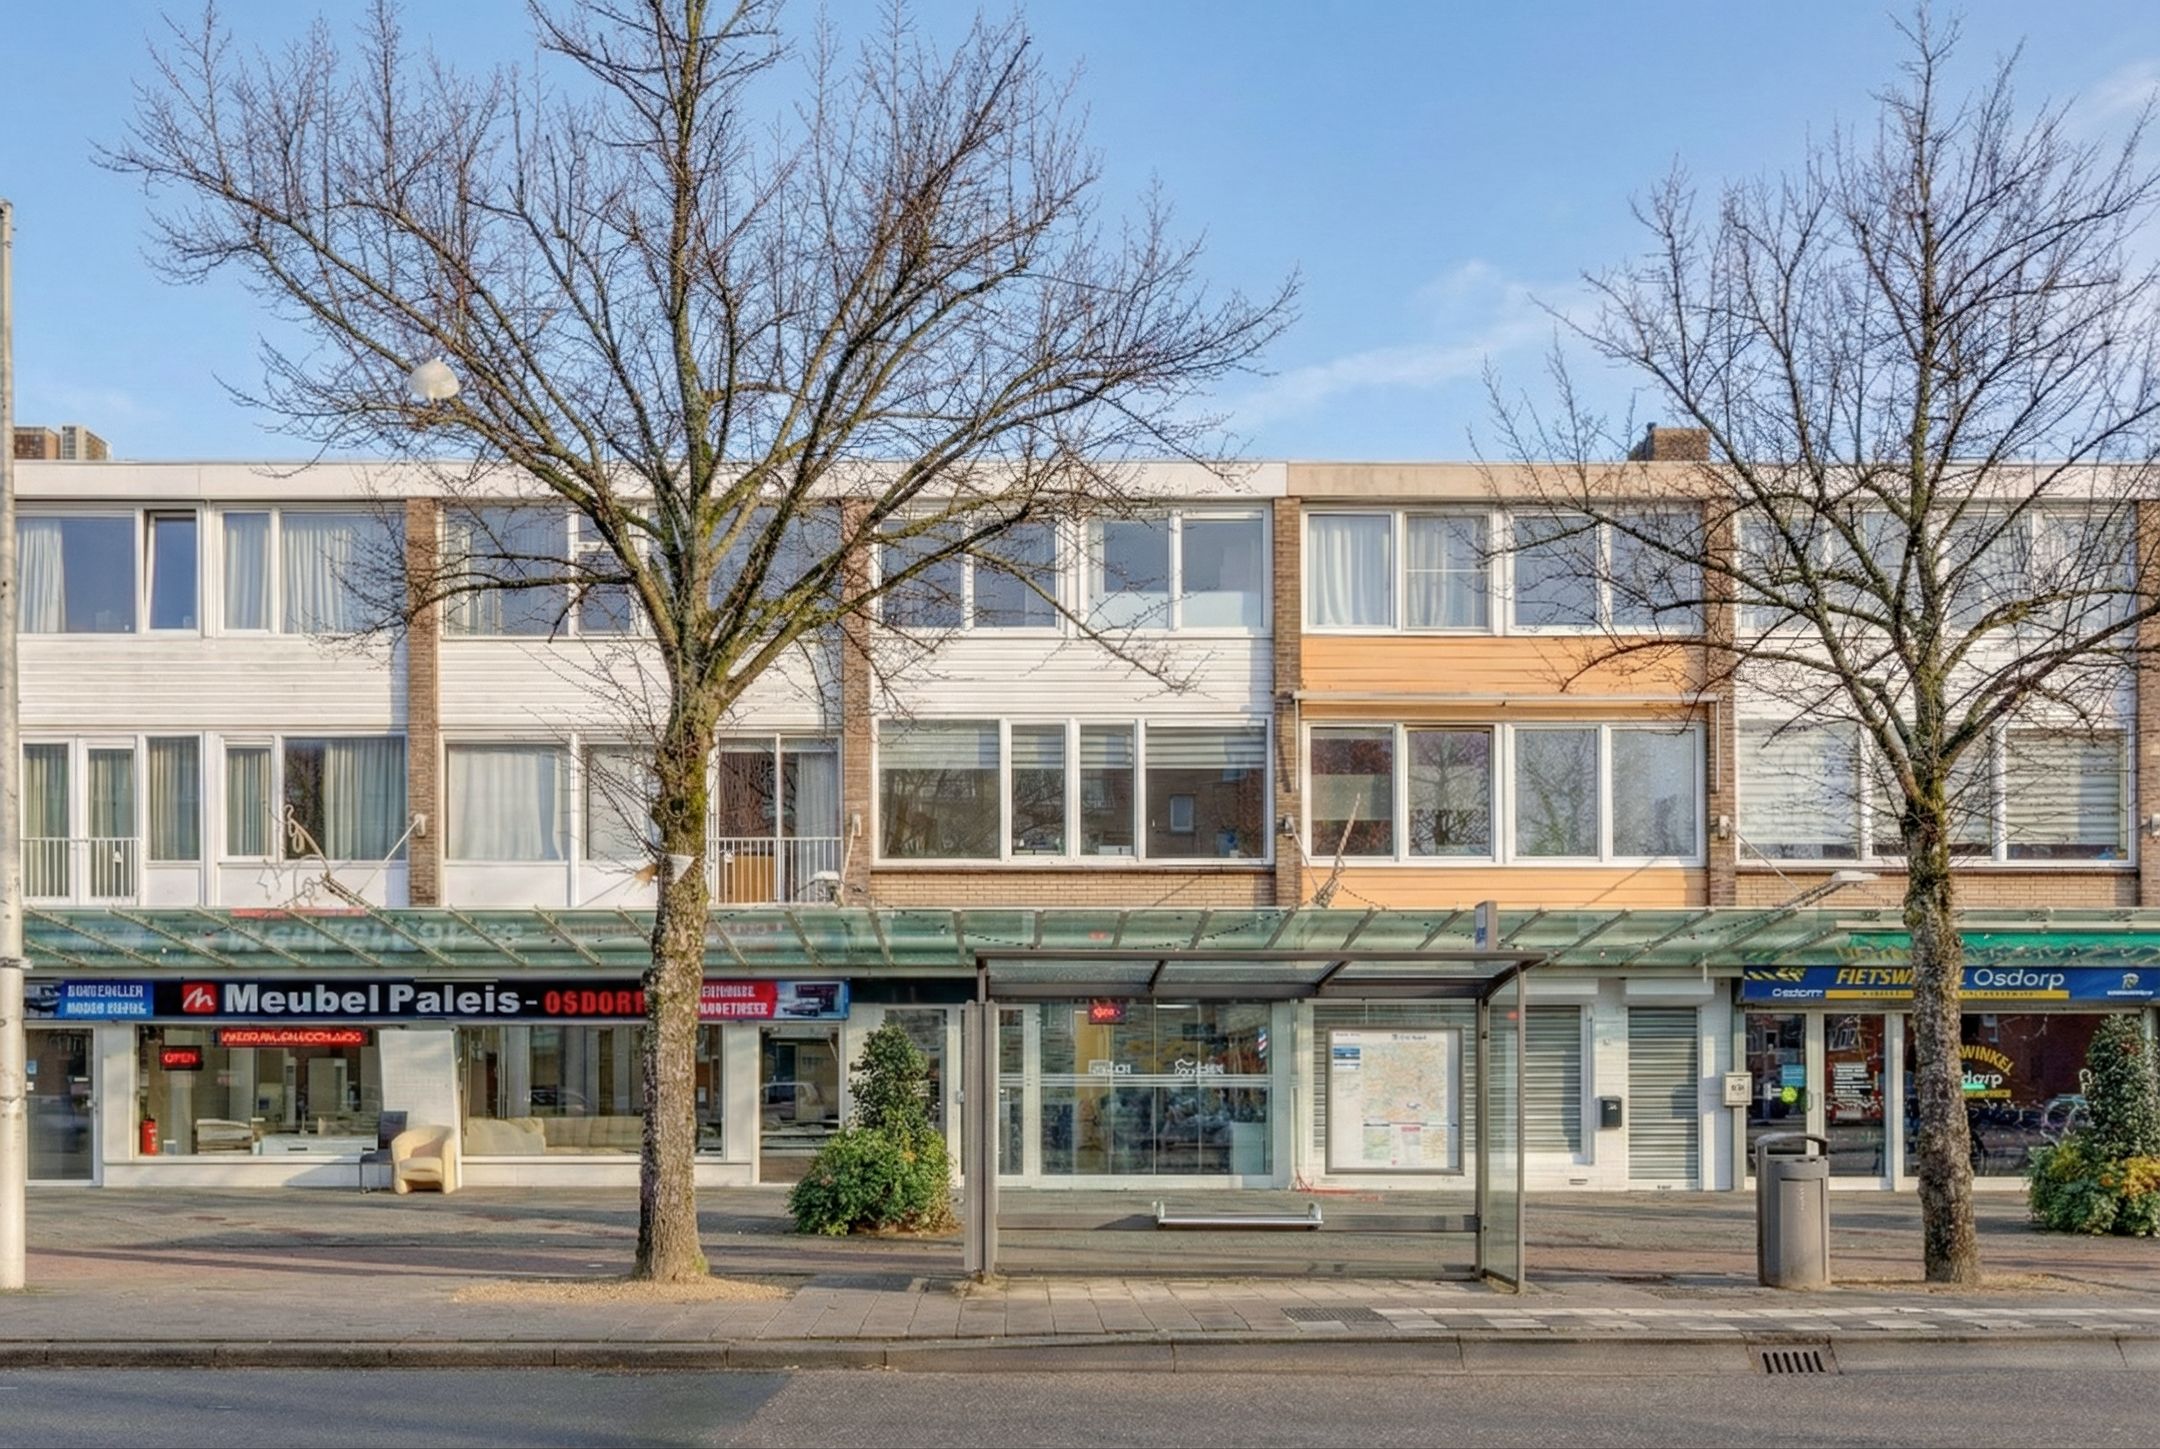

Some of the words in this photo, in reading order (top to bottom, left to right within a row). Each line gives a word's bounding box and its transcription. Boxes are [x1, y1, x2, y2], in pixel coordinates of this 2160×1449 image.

[1974, 968, 2064, 991] Osdorp
[224, 984, 379, 1013] Meubel
[164, 1050, 197, 1064] OPEN
